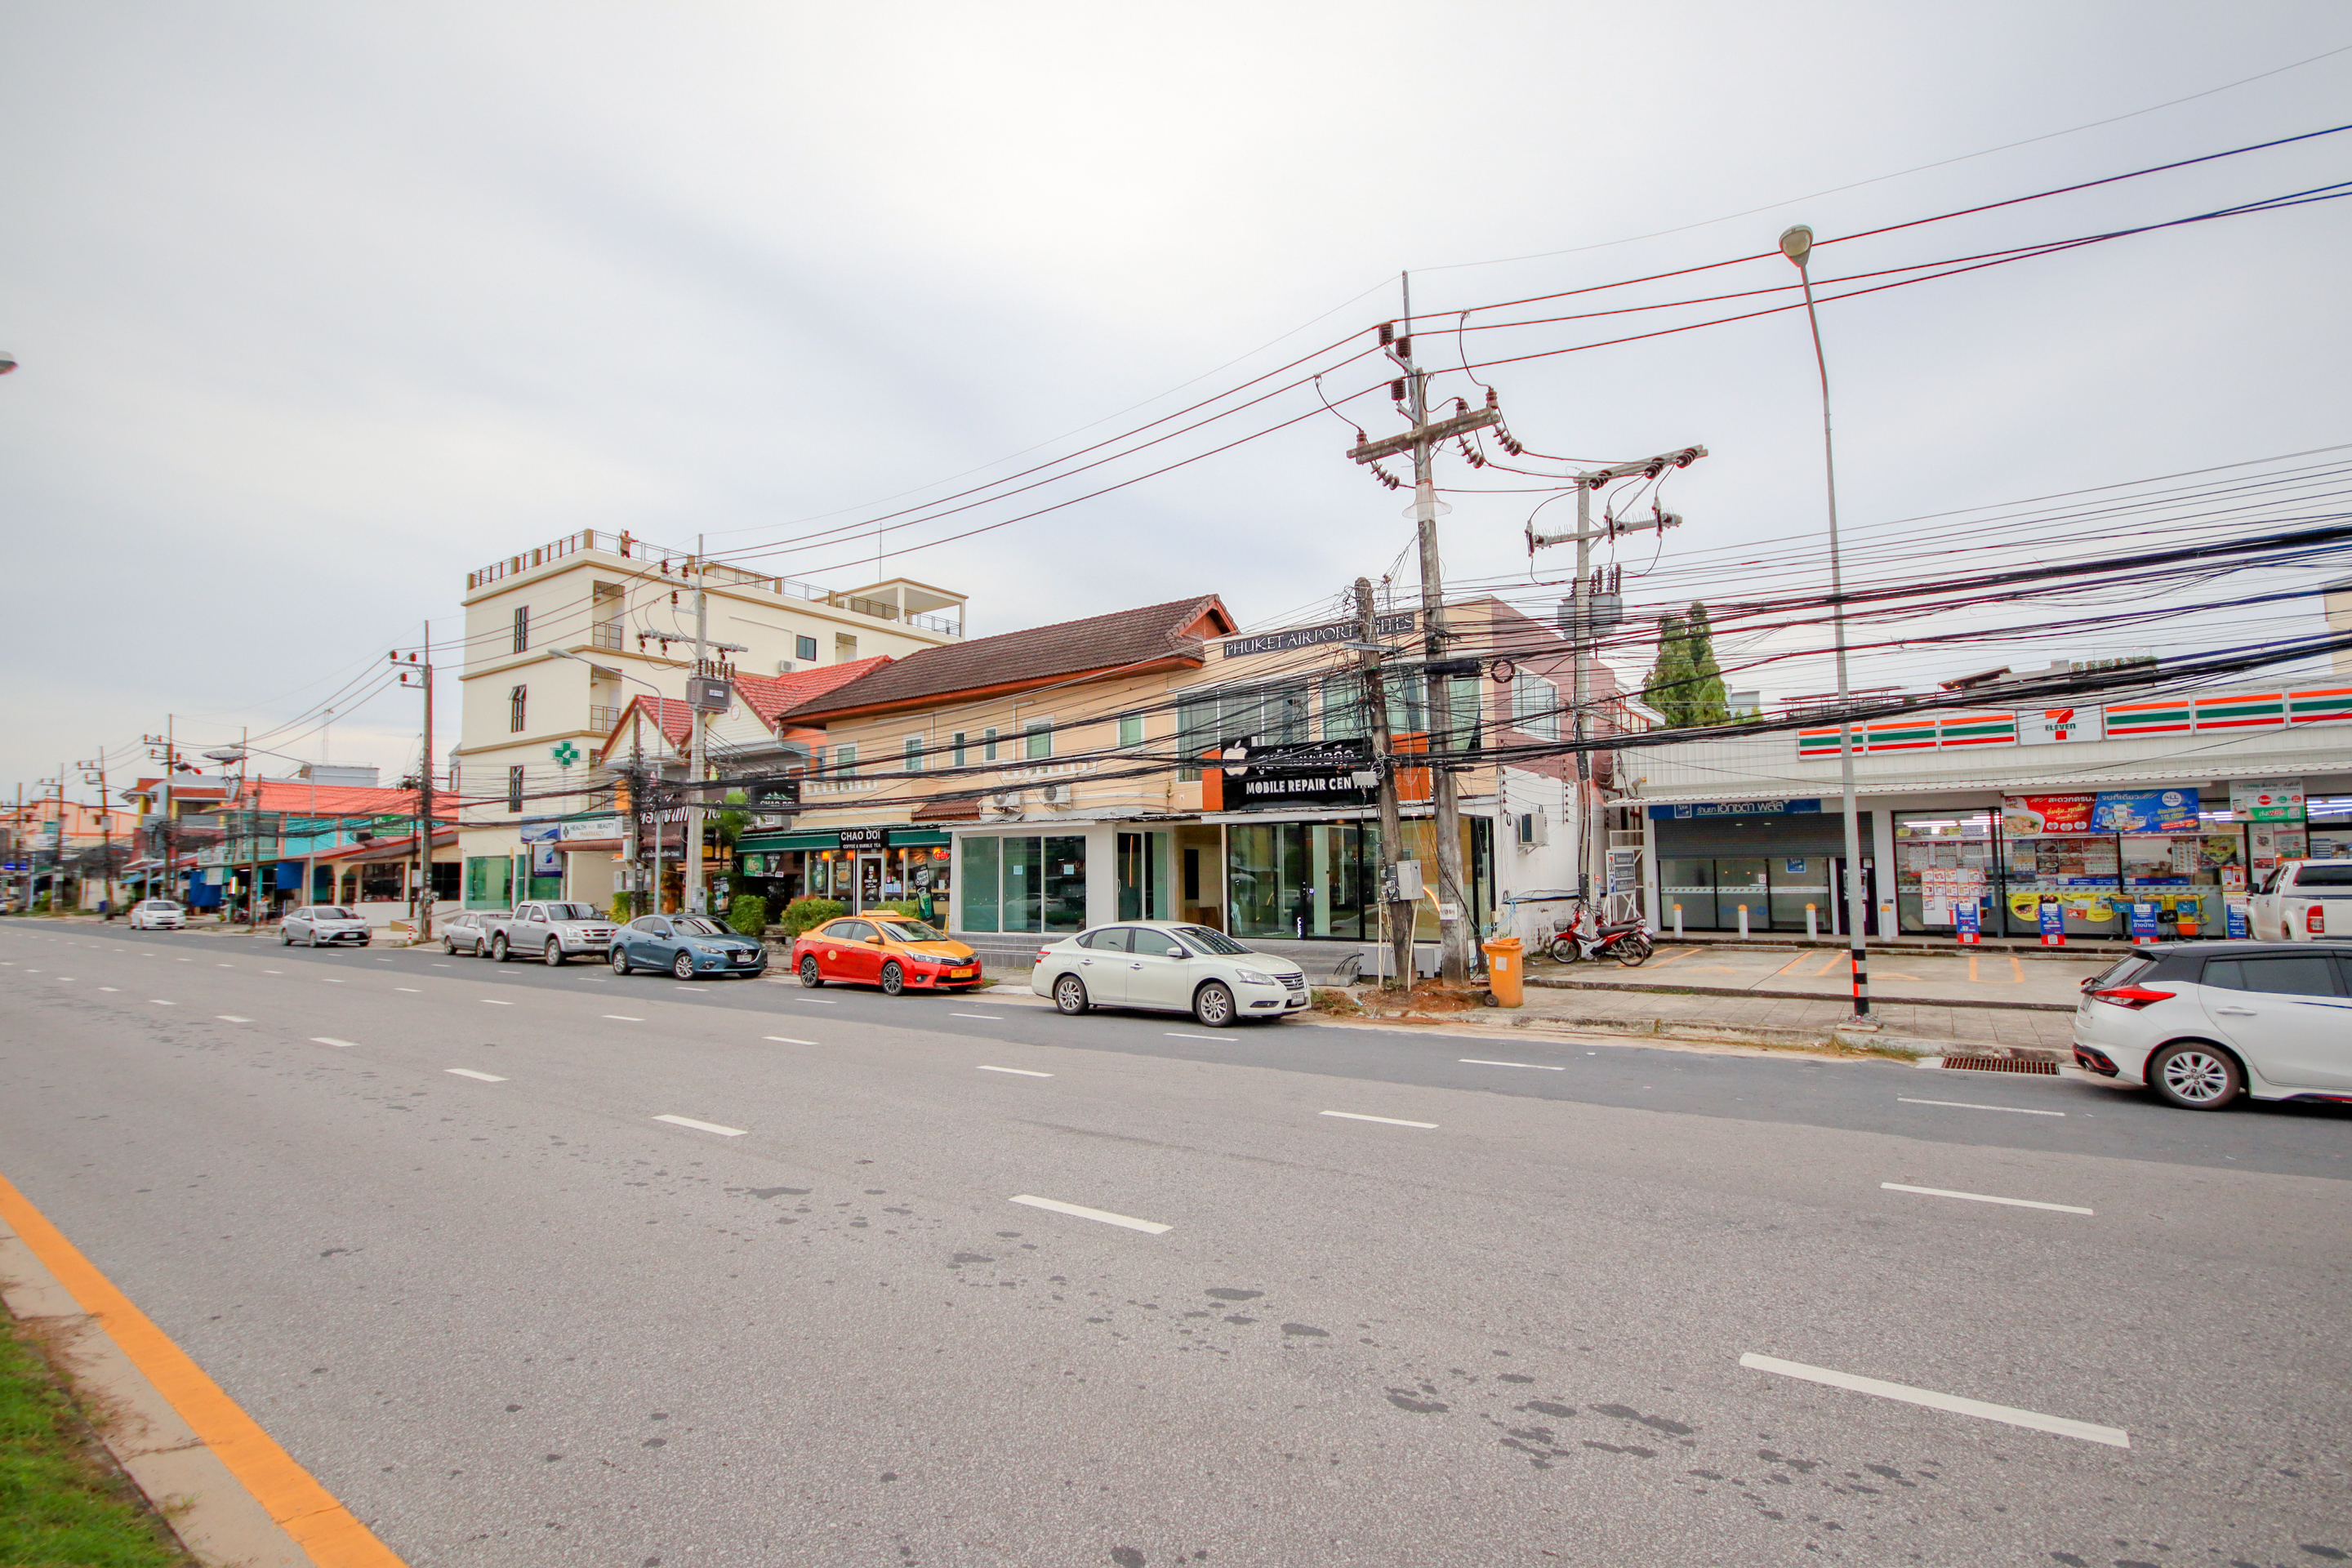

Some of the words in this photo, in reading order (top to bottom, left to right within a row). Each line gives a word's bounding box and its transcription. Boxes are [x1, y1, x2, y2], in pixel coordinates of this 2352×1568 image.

[1226, 635, 1284, 656] PHUKET
[1287, 623, 1354, 647] AIRPORT
[1377, 614, 1414, 634] ITES
[1245, 780, 1285, 795] MOBILE
[1288, 778, 1325, 792] REPAIR
[1697, 805, 1716, 814] ร้านยา
[840, 830, 864, 841] CHAO
[866, 830, 880, 840] DOI
